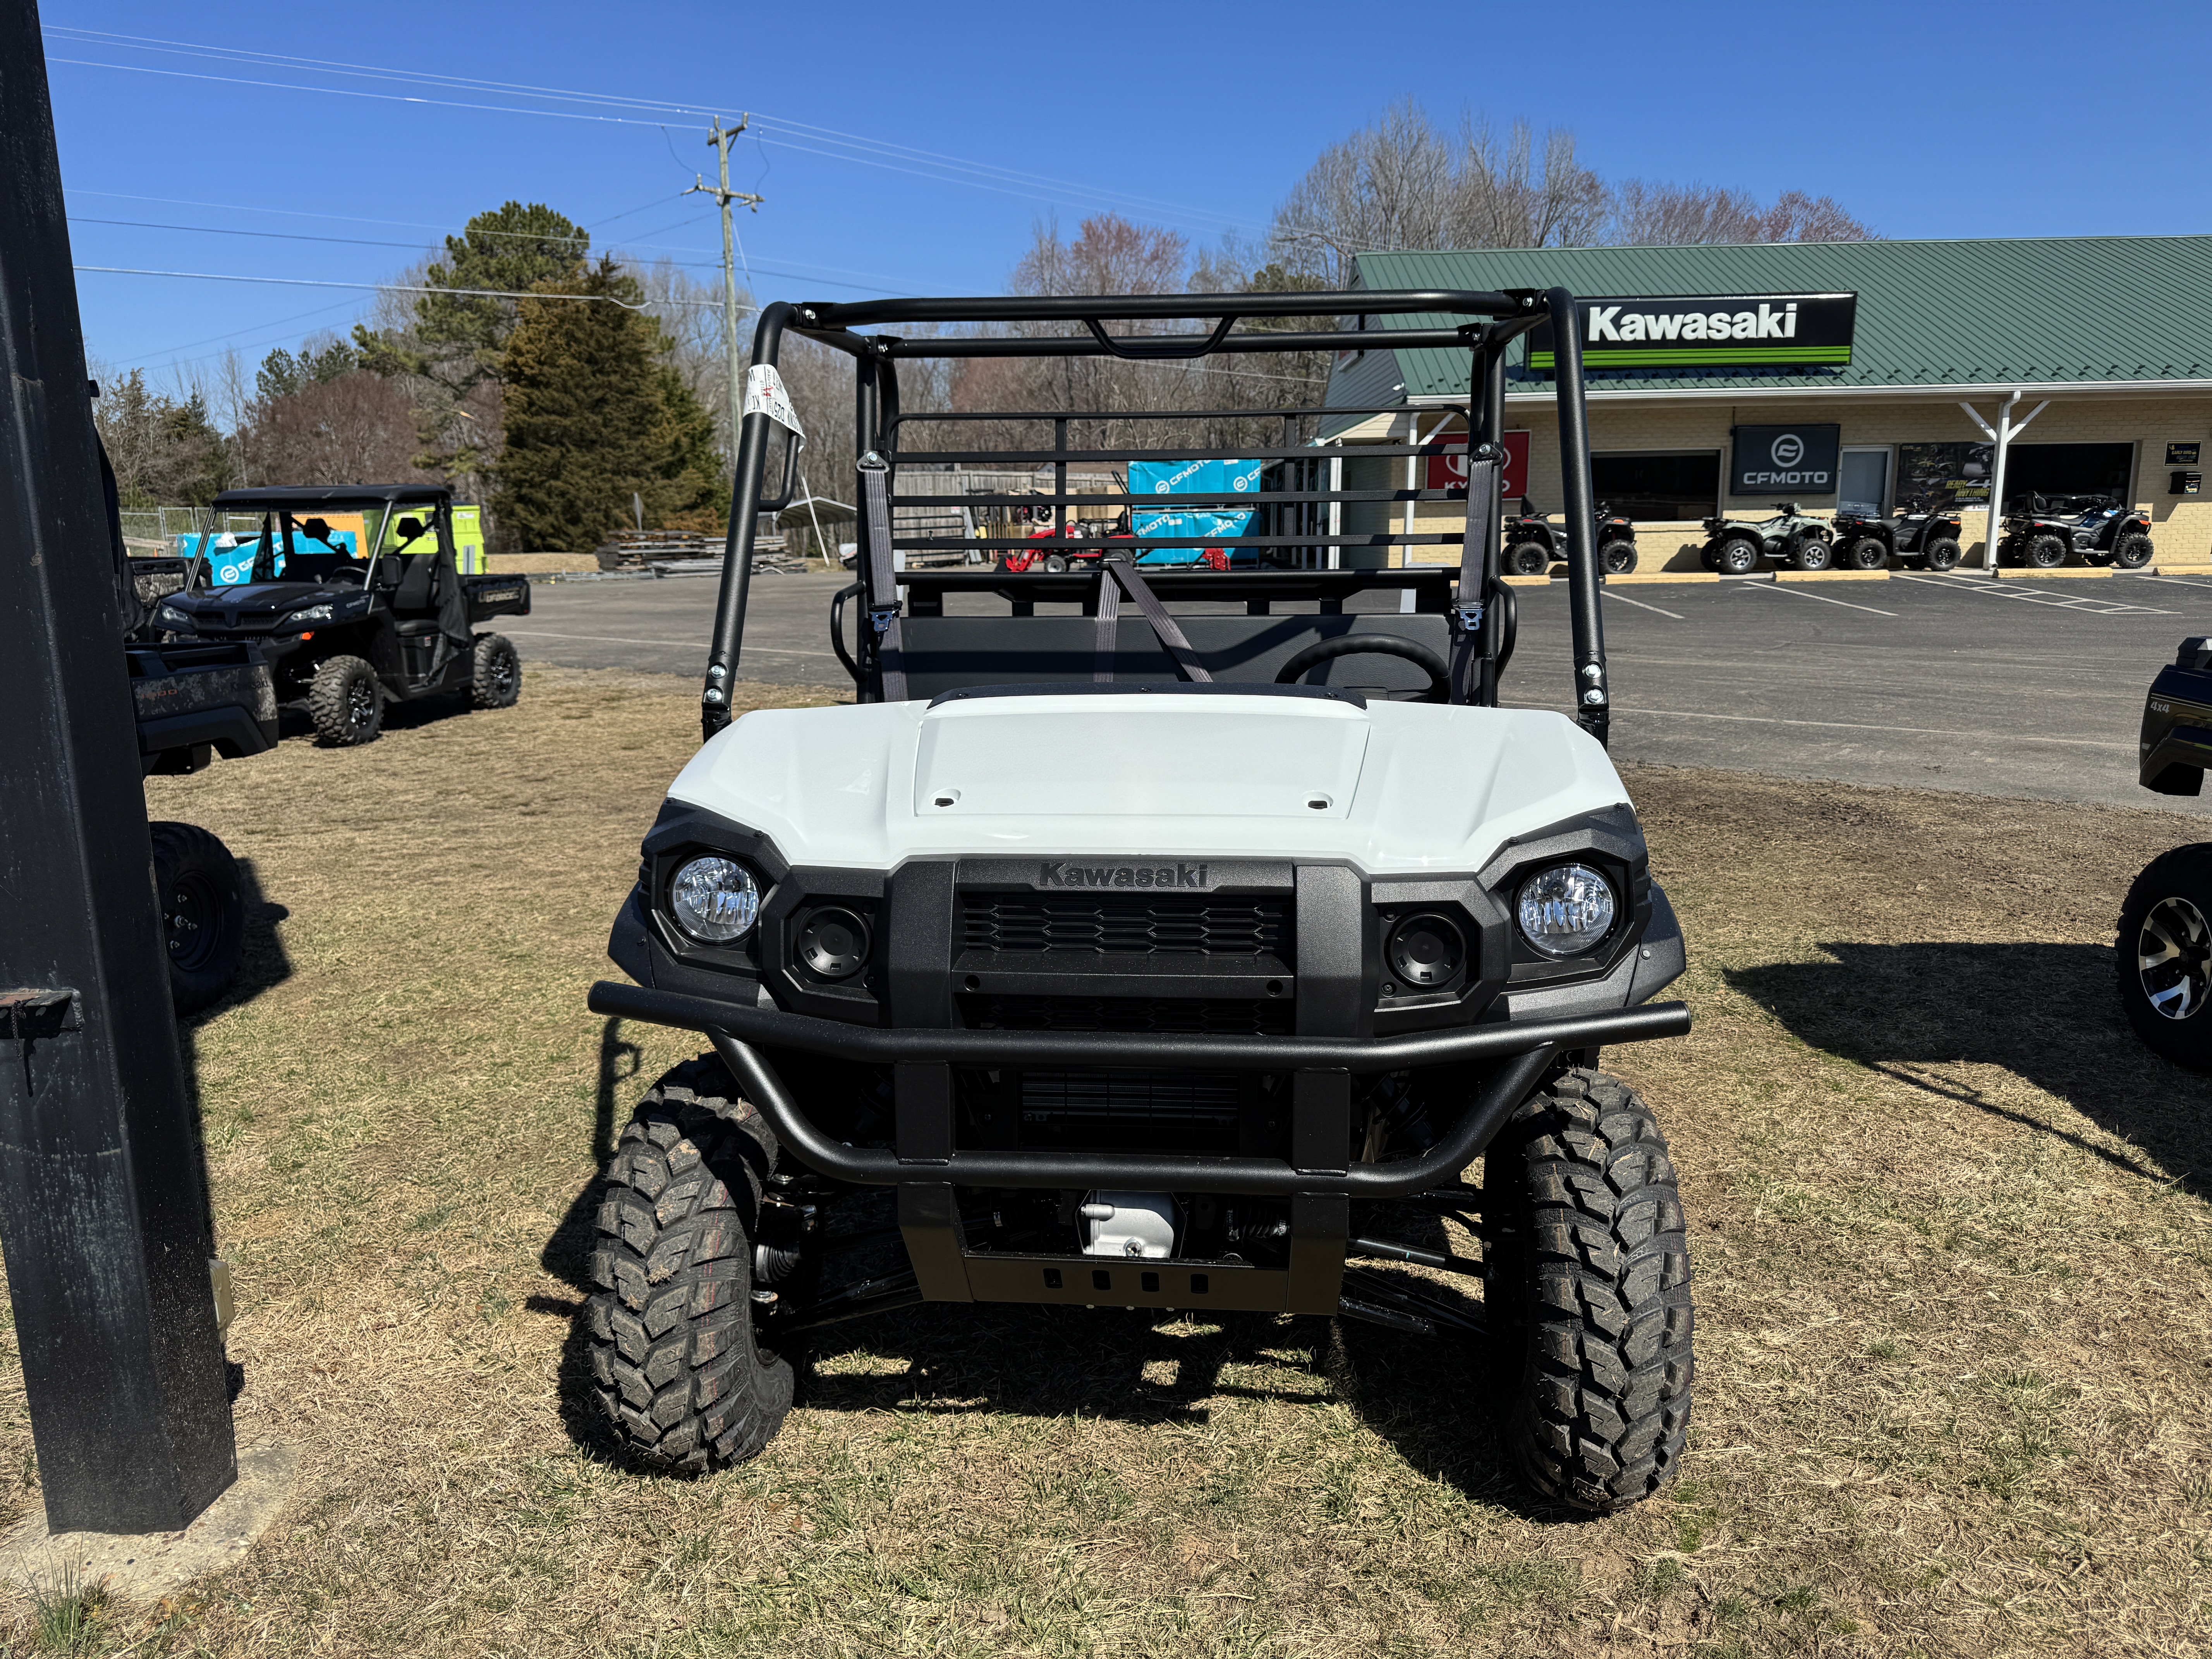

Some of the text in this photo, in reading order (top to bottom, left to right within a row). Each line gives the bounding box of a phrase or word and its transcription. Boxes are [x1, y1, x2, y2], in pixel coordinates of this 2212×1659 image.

[1589, 304, 1797, 341] Kawasaki
[1743, 472, 1828, 484] CFMOTO
[1945, 479, 1991, 489] READY 4
[1955, 488, 1990, 497] ANYTHING
[1136, 514, 1170, 535] FMOTO
[2150, 701, 2169, 713] 4x4
[1040, 862, 1208, 887] Kawasaki
